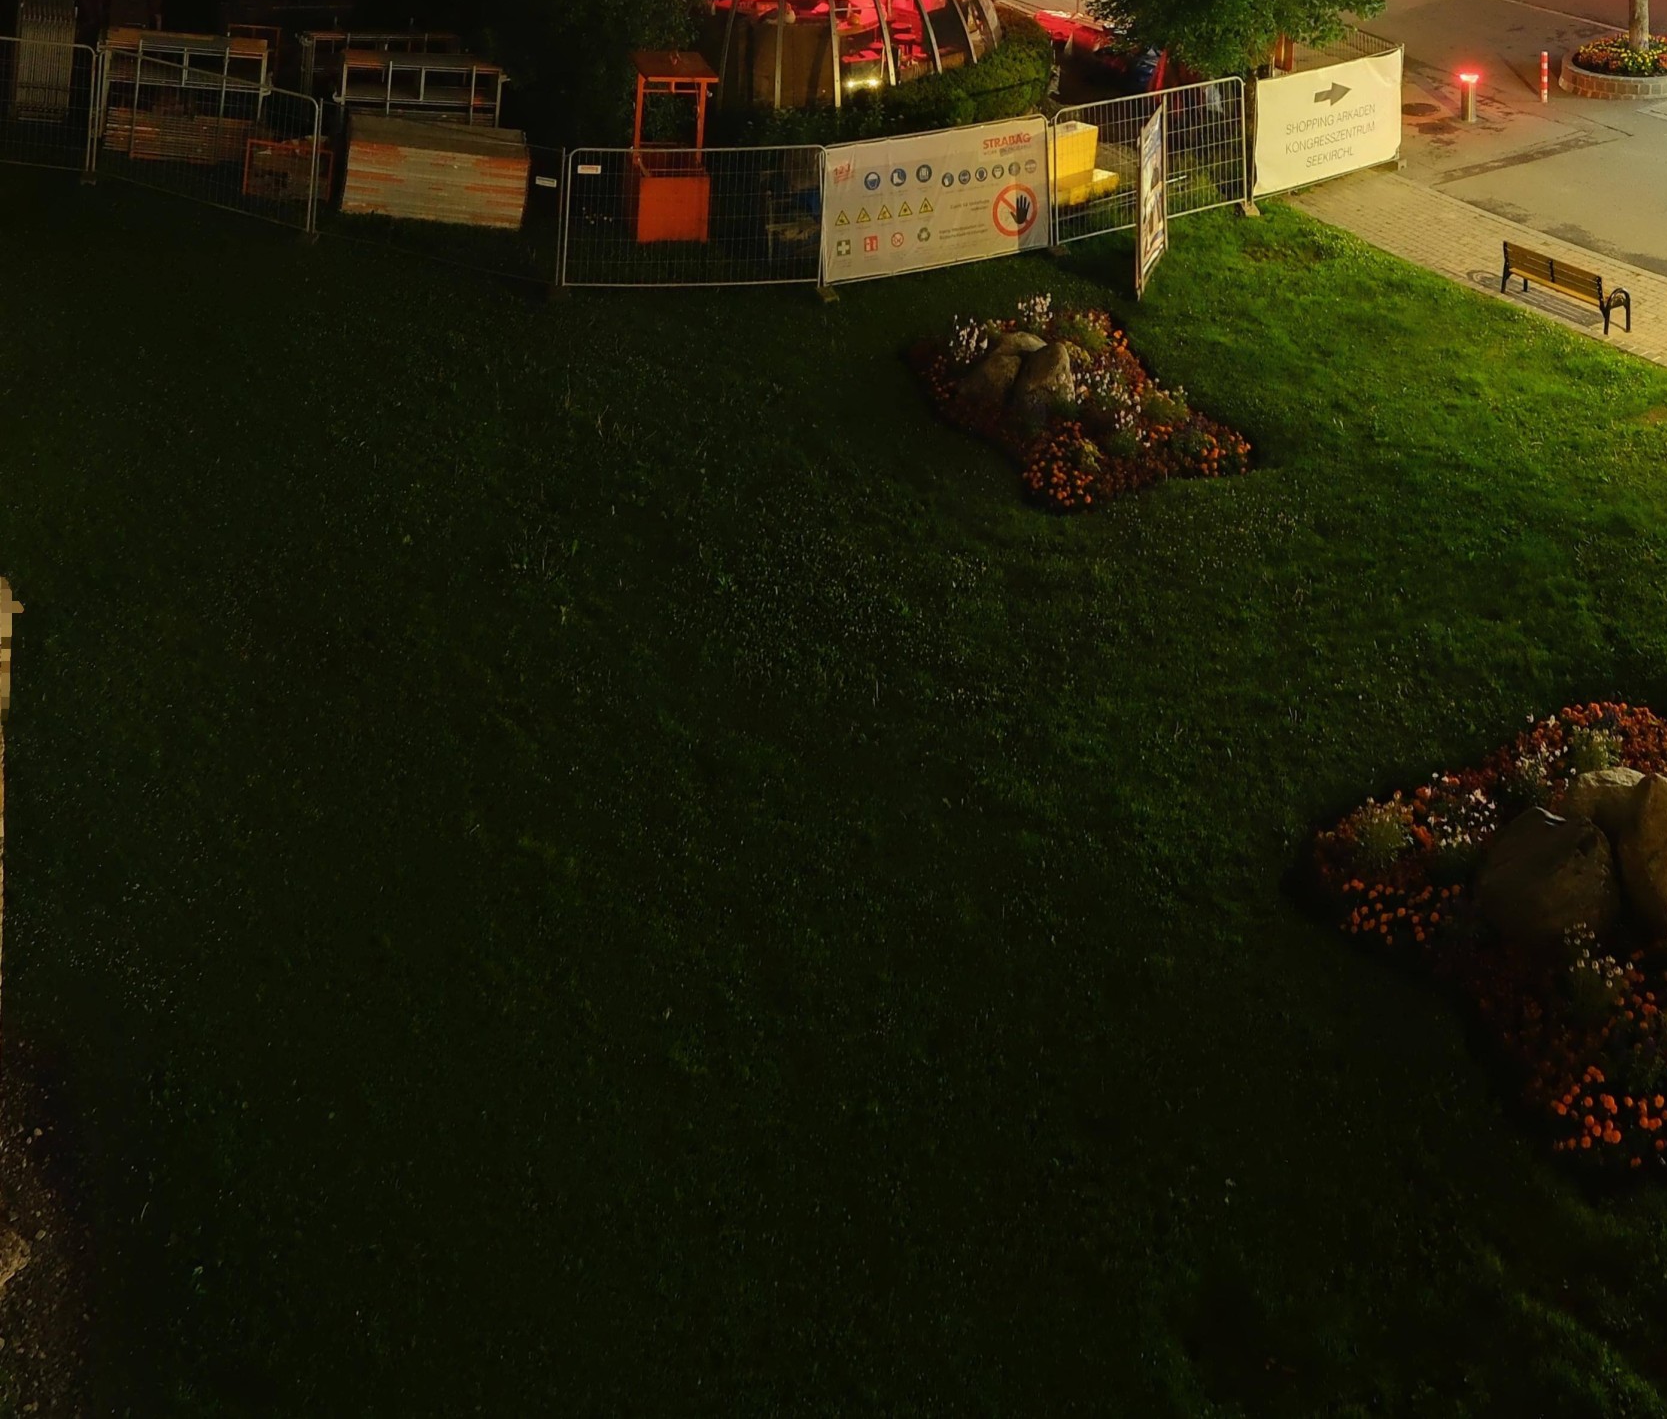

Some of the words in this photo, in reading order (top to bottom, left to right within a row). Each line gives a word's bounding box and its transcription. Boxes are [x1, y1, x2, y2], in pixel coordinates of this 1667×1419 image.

[1284, 114, 1335, 135] SHOPPING
[1336, 105, 1375, 124] ARKADEN
[983, 133, 1032, 150] STRABAG
[1284, 122, 1375, 156] KONGRESSZENTRUM
[1305, 147, 1354, 168] SEEKIRCHL
